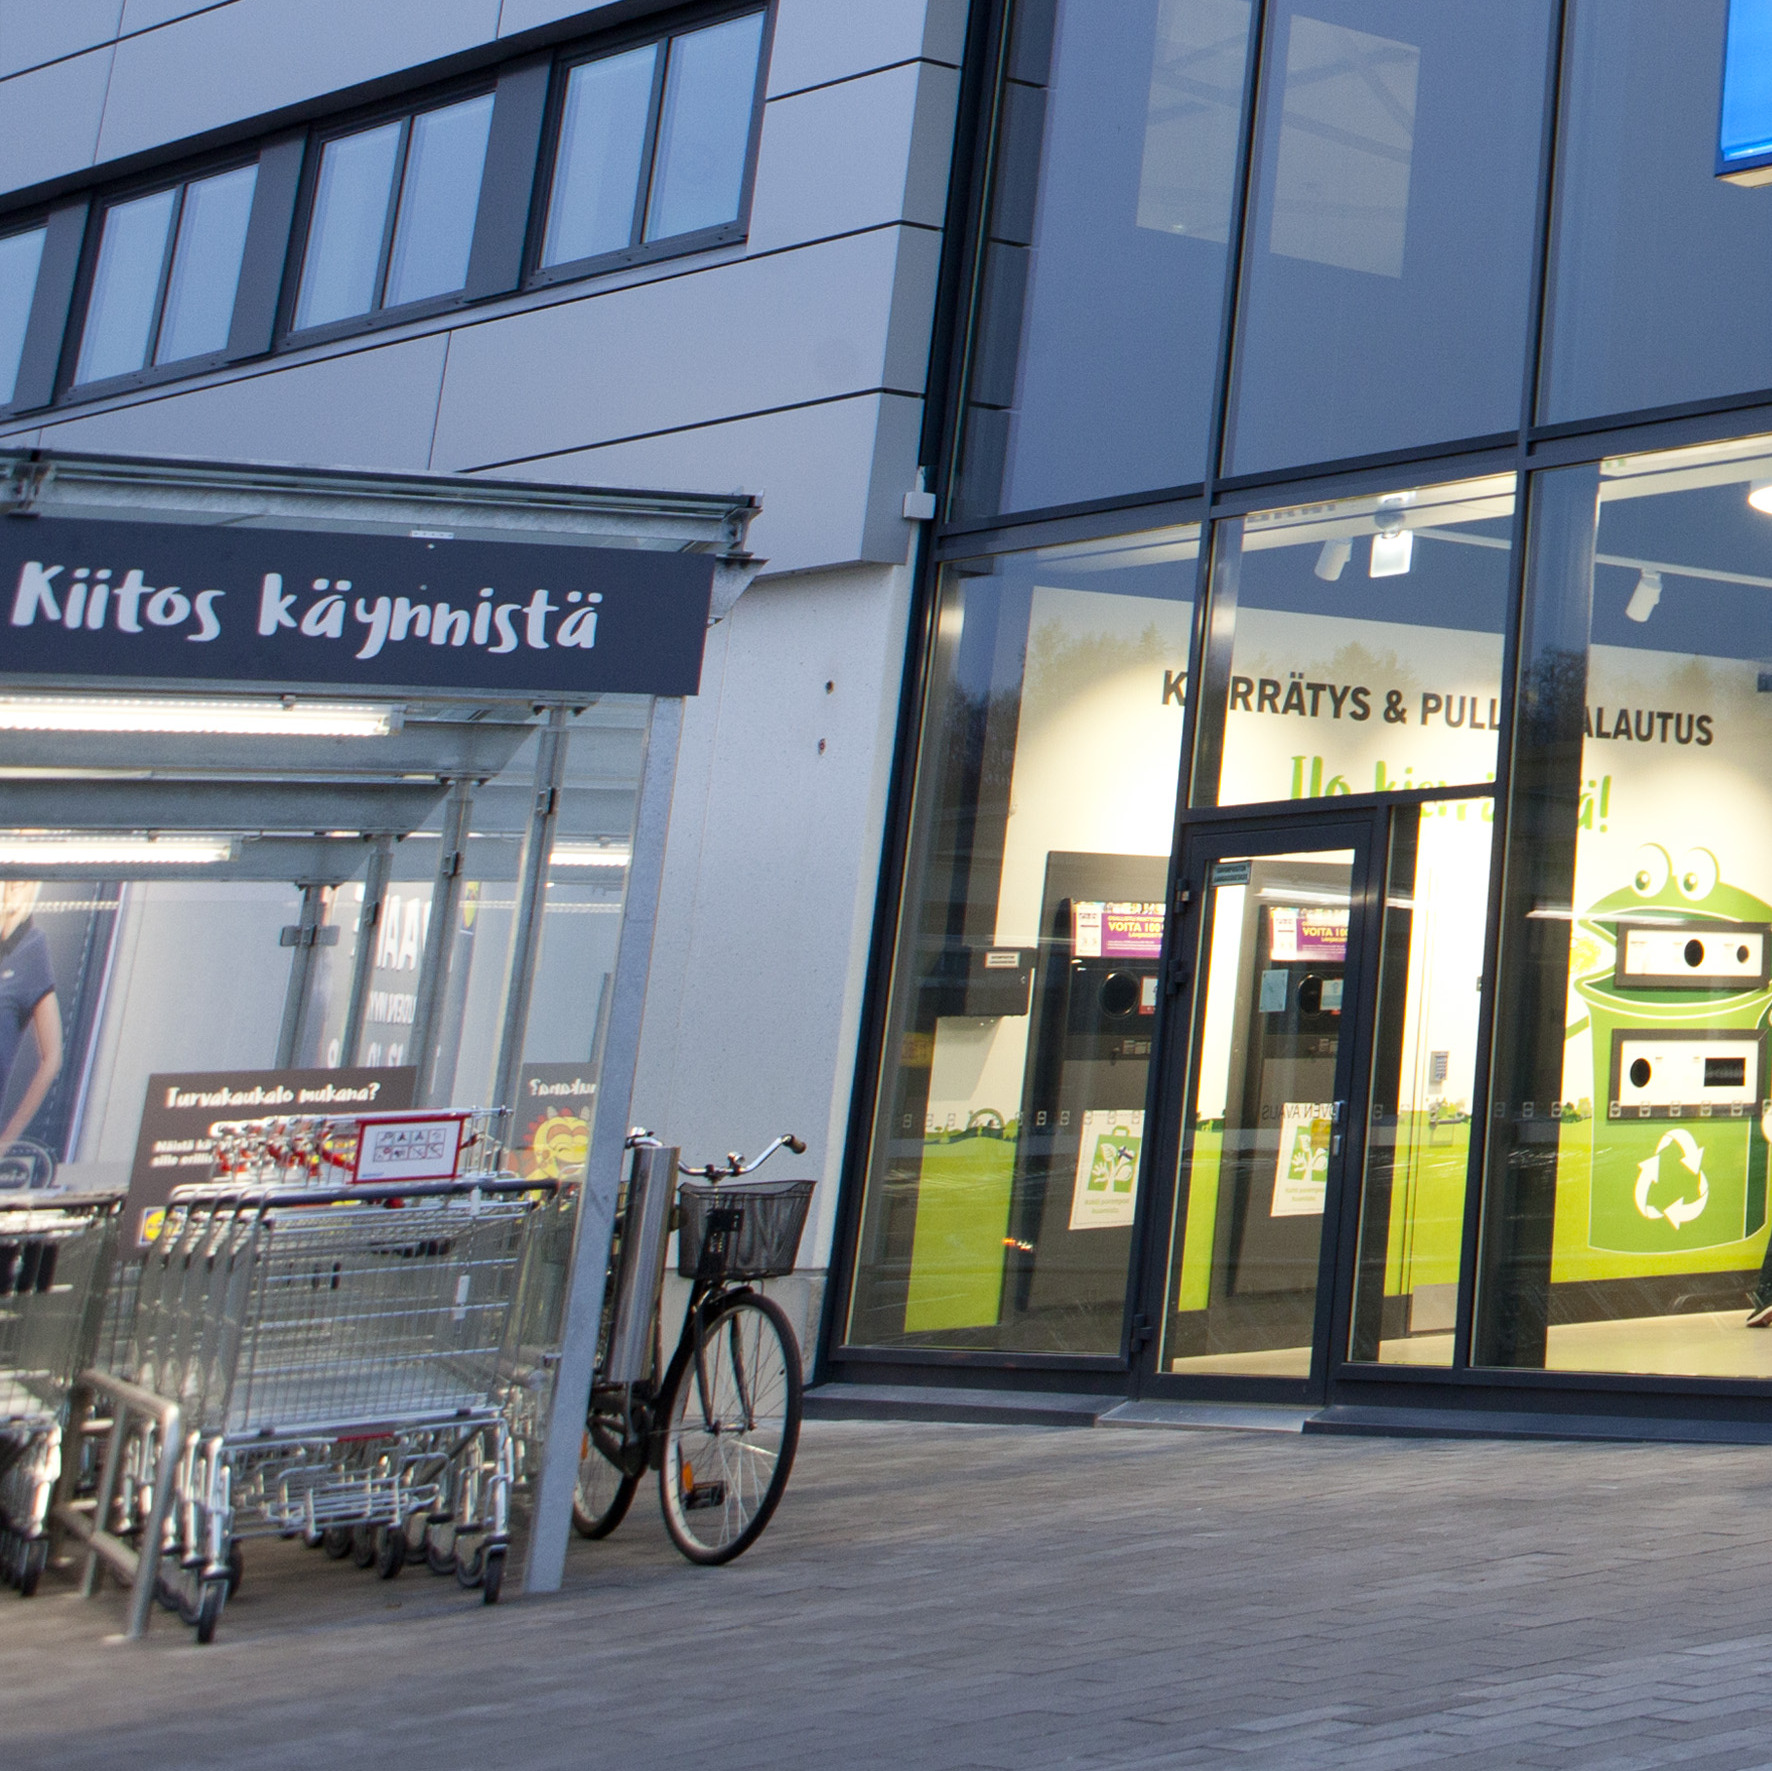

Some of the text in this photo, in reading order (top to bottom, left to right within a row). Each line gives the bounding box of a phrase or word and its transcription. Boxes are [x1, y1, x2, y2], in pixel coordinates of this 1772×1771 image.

[11, 561, 604, 660] Kiitos käynnistä
[1162, 669, 1372, 722] KRRÄTYS
[1384, 689, 1408, 725] &
[1108, 922, 1142, 932] VOITA
[1302, 927, 1333, 937] VOITA
[165, 1082, 381, 1109] Turvakaukalo mukana?
